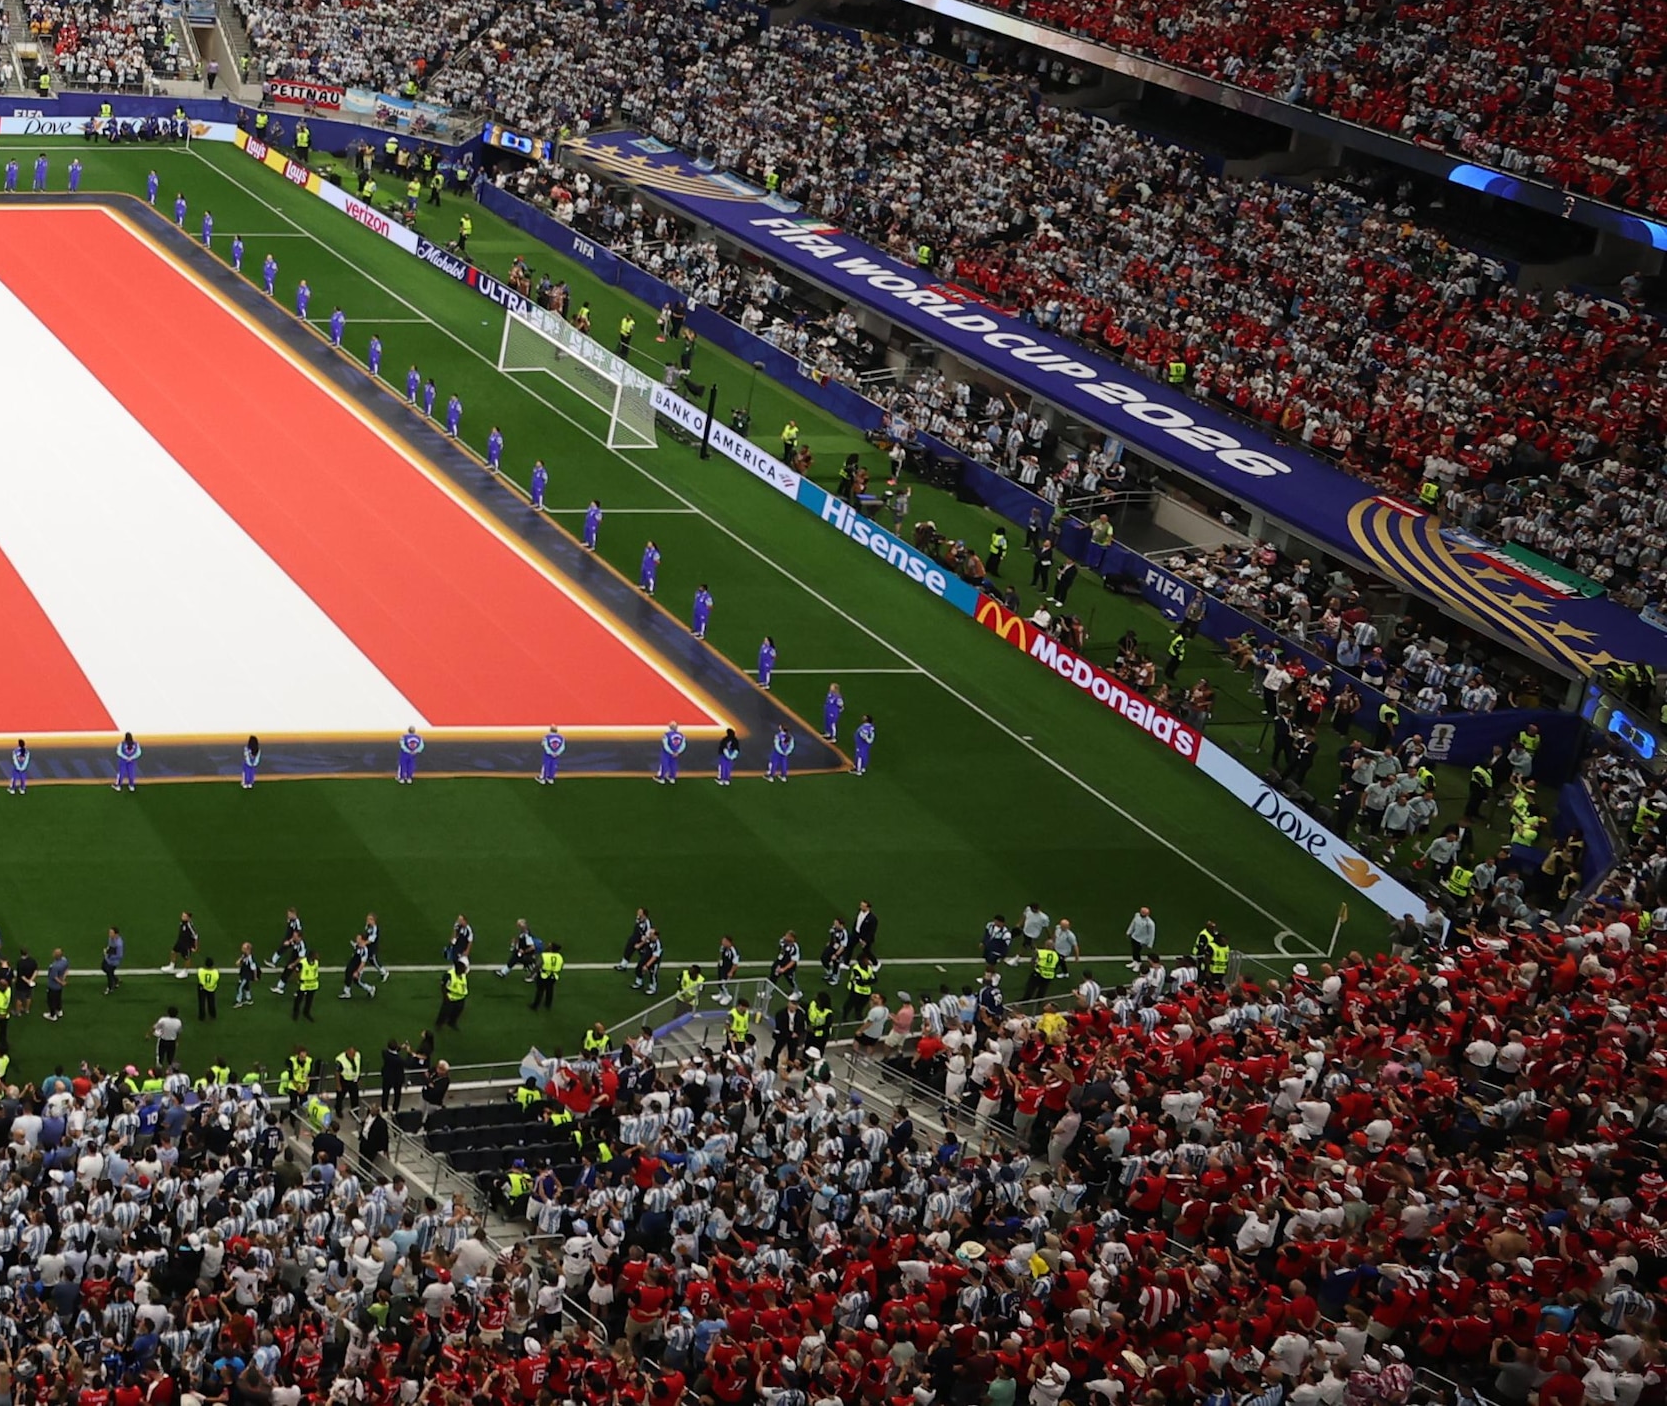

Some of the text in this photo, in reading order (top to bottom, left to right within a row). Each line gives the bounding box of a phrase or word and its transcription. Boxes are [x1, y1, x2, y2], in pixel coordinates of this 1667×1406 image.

[271, 83, 340, 104] PETTNAU
[24, 118, 72, 135] Dove
[246, 137, 266, 161] Lay's
[286, 160, 308, 185] Lay's
[345, 199, 390, 236] verizon
[572, 237, 595, 260] FIFA
[416, 240, 528, 316] Michelob ULTRA
[749, 217, 1293, 477] FIFA WORLD CUP 2026
[655, 391, 690, 423] BANK
[713, 430, 777, 480] AMERICA
[820, 493, 947, 597] Hisense
[1145, 568, 1186, 606] FIFA
[1029, 633, 1195, 756] McDonald's
[1252, 783, 1327, 857] Dove
[1221, 1067, 1233, 1079] 16
[700, 1292, 710, 1305] 8
